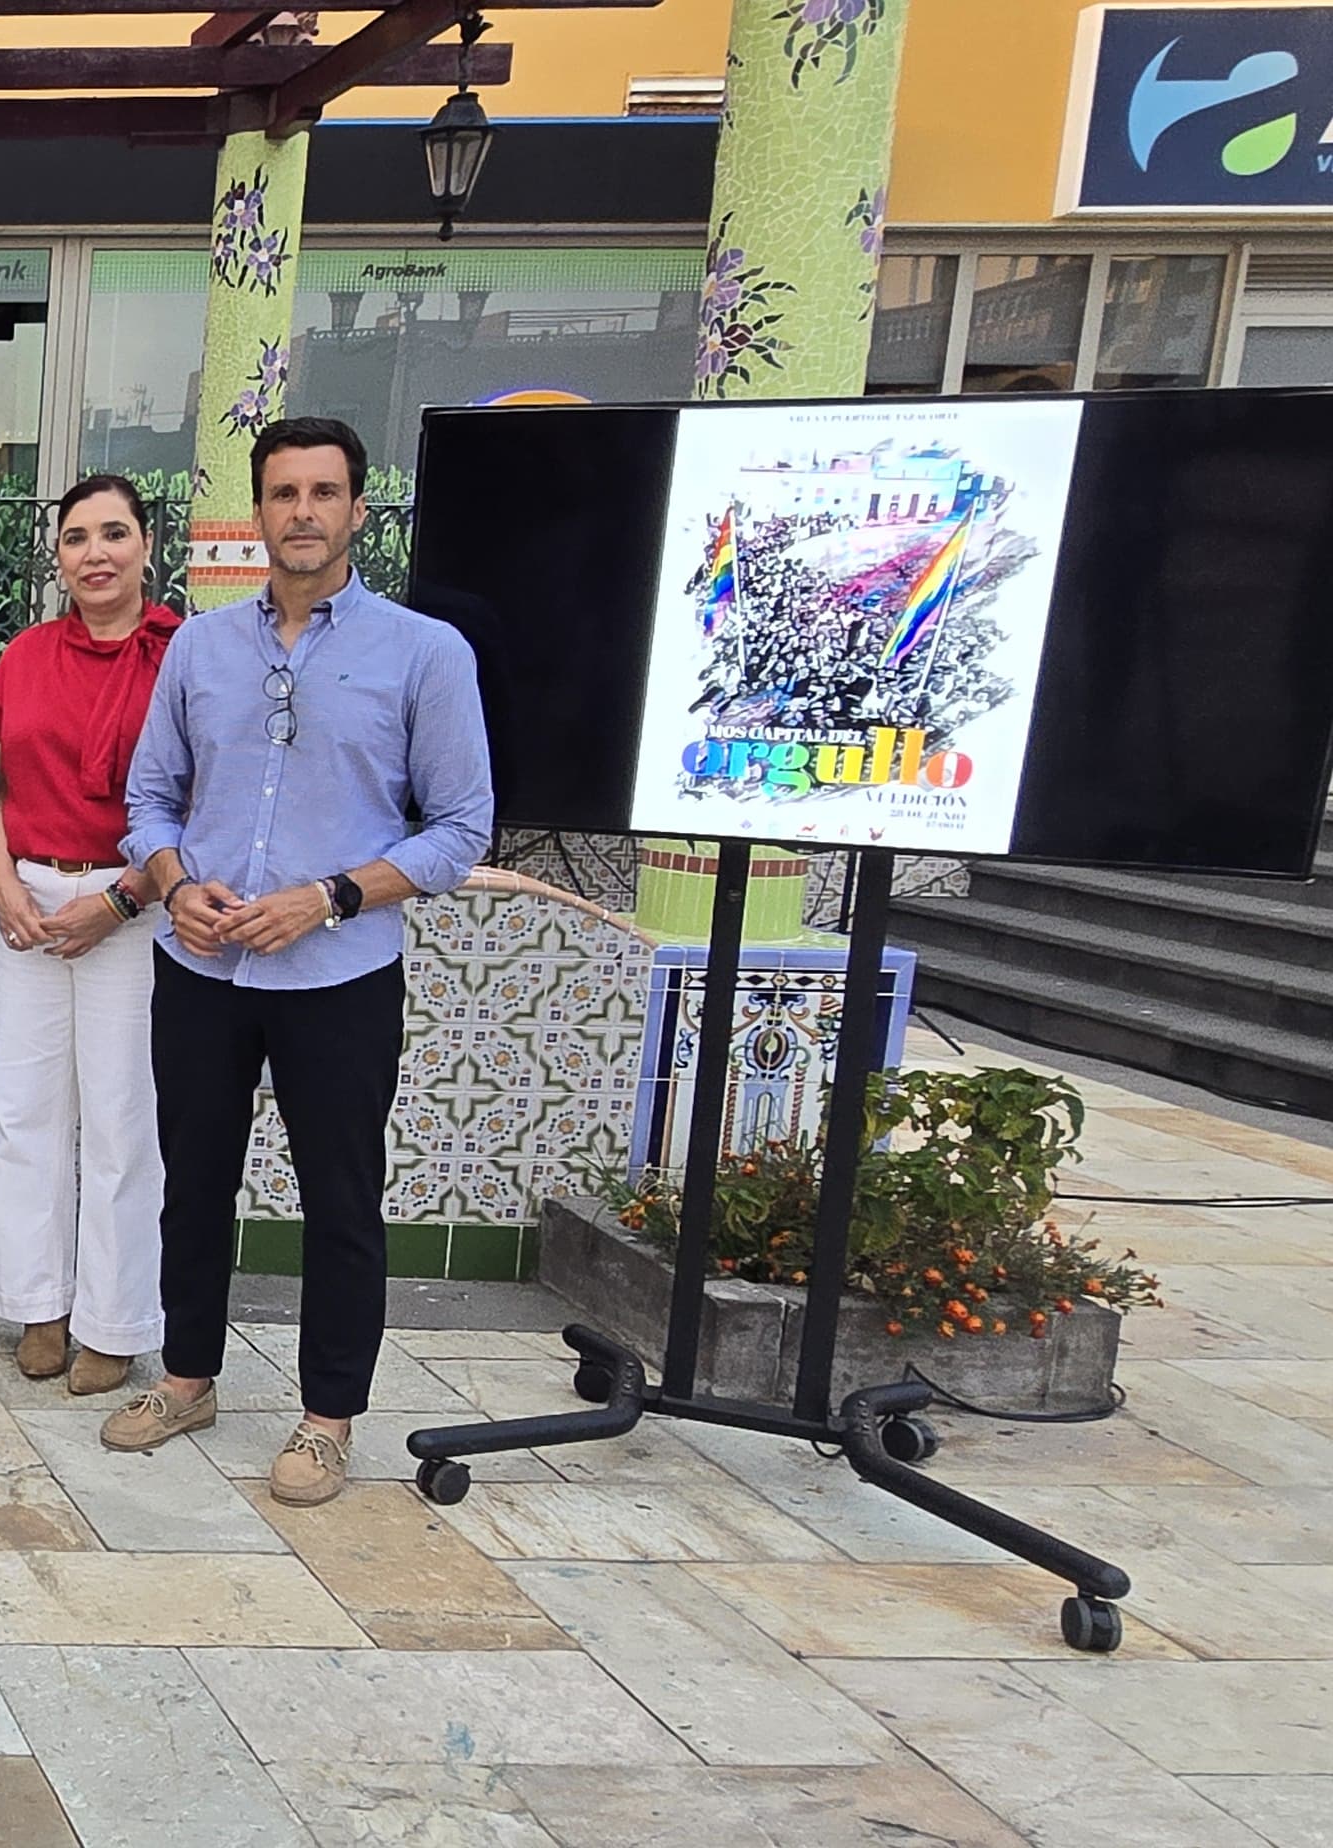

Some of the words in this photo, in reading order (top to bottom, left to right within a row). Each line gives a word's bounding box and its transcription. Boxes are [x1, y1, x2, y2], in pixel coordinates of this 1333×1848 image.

[362, 262, 447, 281] AgroBank
[827, 729, 866, 745] DEL
[681, 725, 973, 798] orgullo
